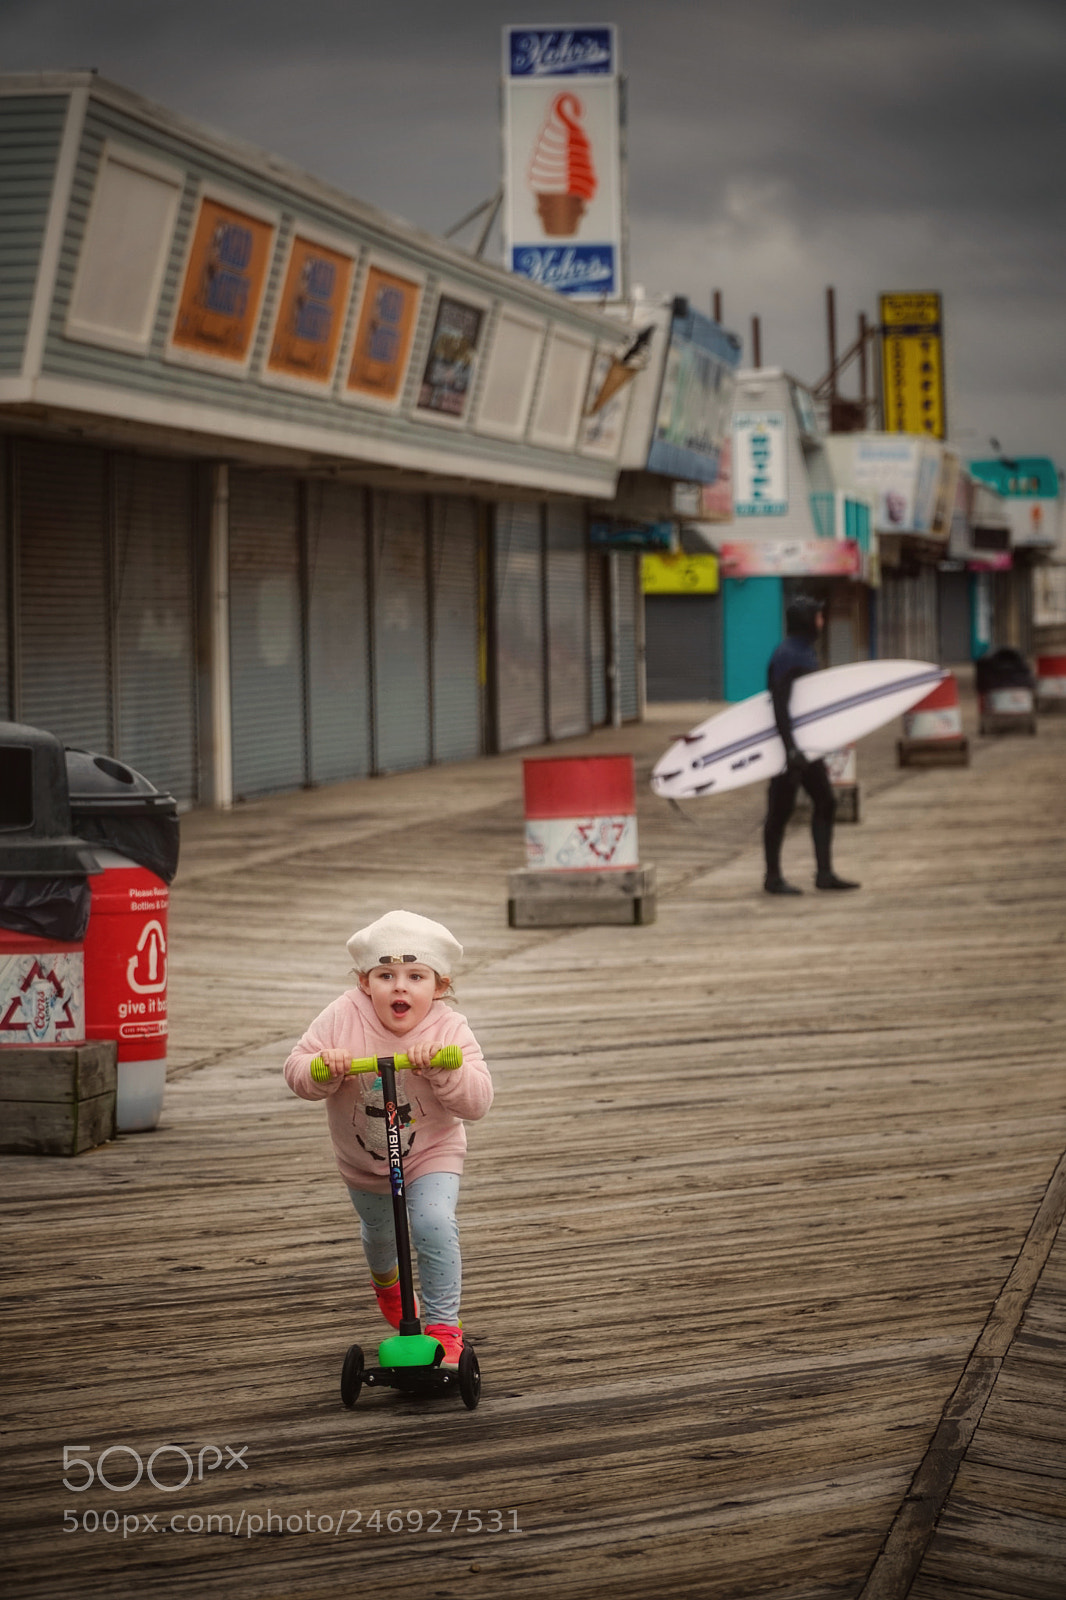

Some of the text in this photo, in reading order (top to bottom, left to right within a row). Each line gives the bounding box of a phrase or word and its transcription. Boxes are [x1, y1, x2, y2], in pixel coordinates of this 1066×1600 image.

[131, 901, 155, 911] Bottles
[118, 1000, 146, 1018] give
[148, 998, 155, 1012] it
[388, 1125, 400, 1168] YBIKE
